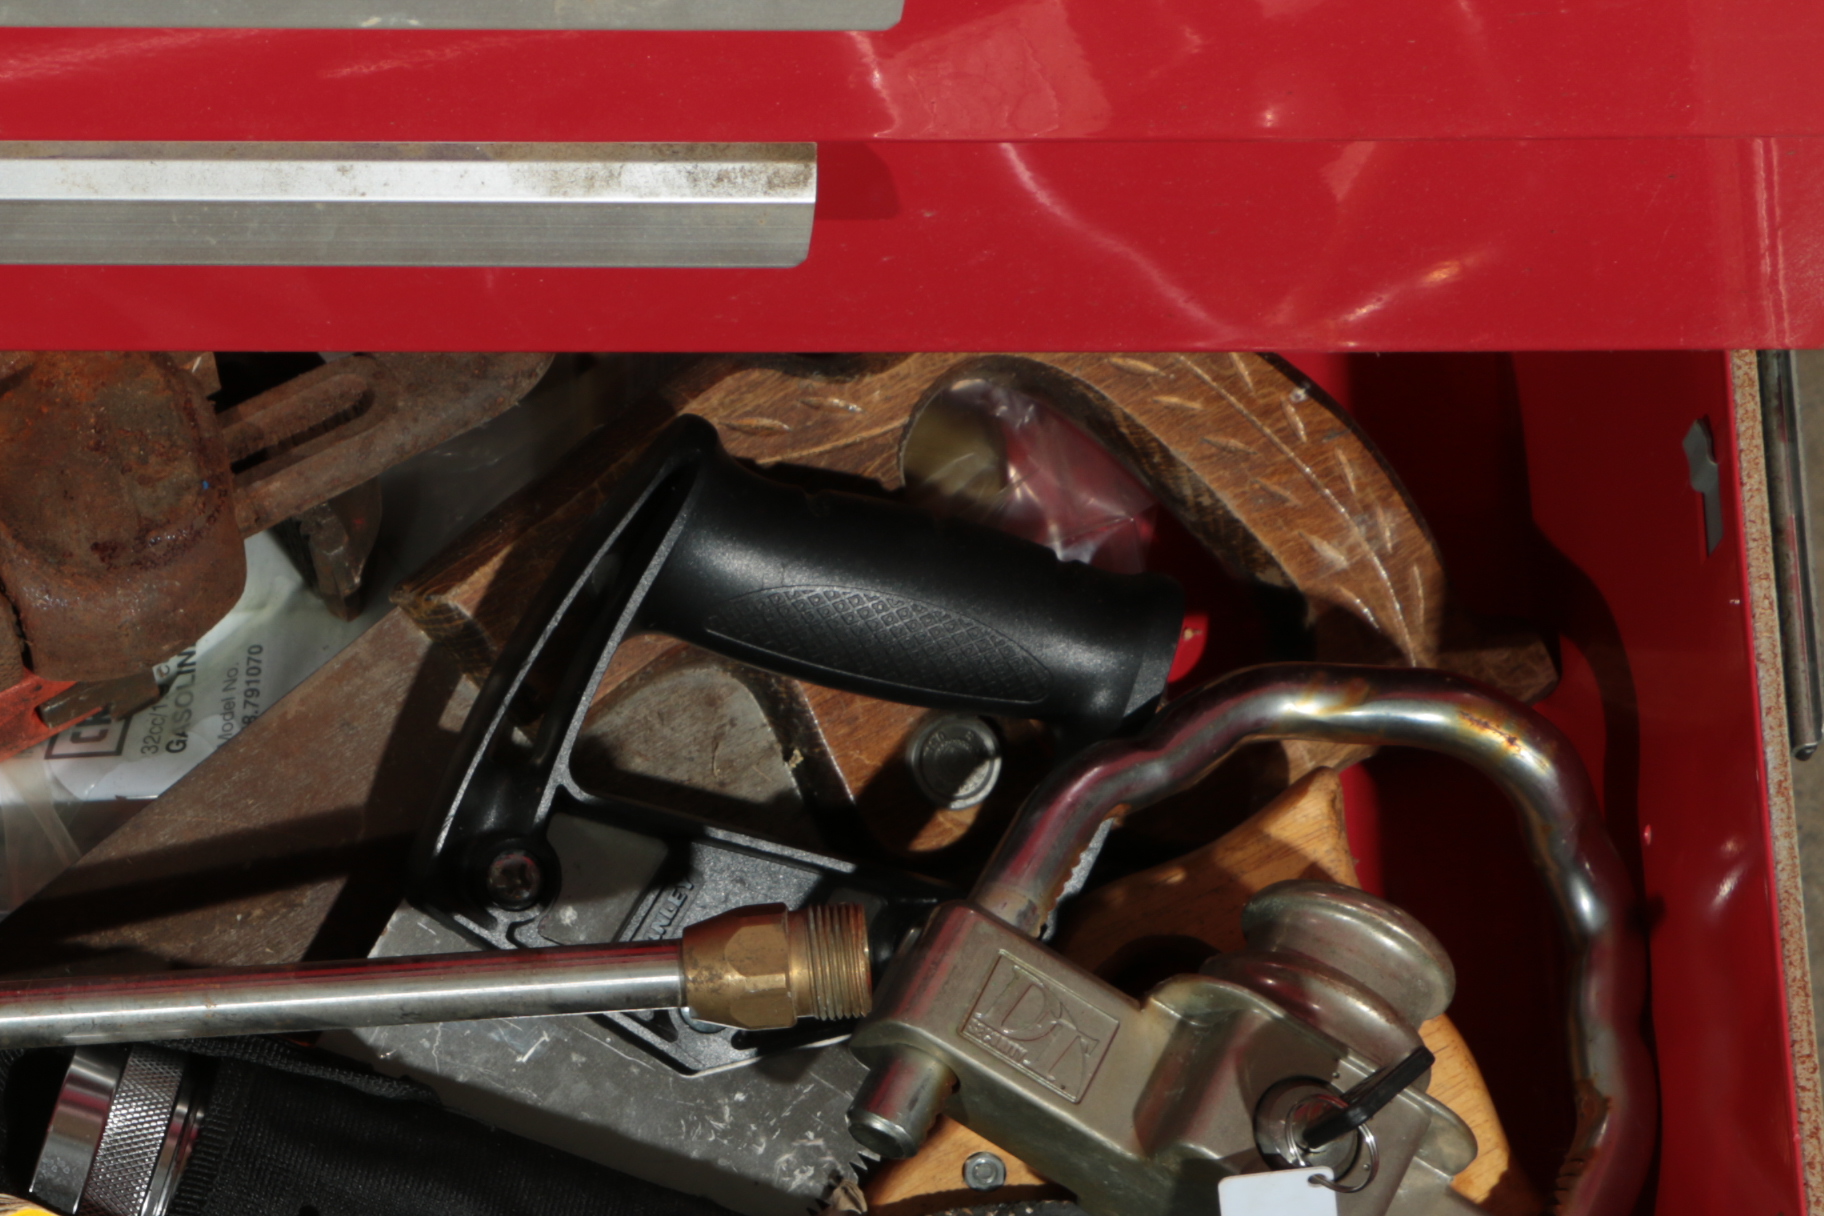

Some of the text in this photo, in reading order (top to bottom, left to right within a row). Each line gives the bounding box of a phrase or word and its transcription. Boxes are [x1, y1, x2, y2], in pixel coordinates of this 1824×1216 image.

[166, 650, 197, 754] GASOLIN
[223, 662, 239, 694] No.
[242, 644, 264, 730] 8.791070
